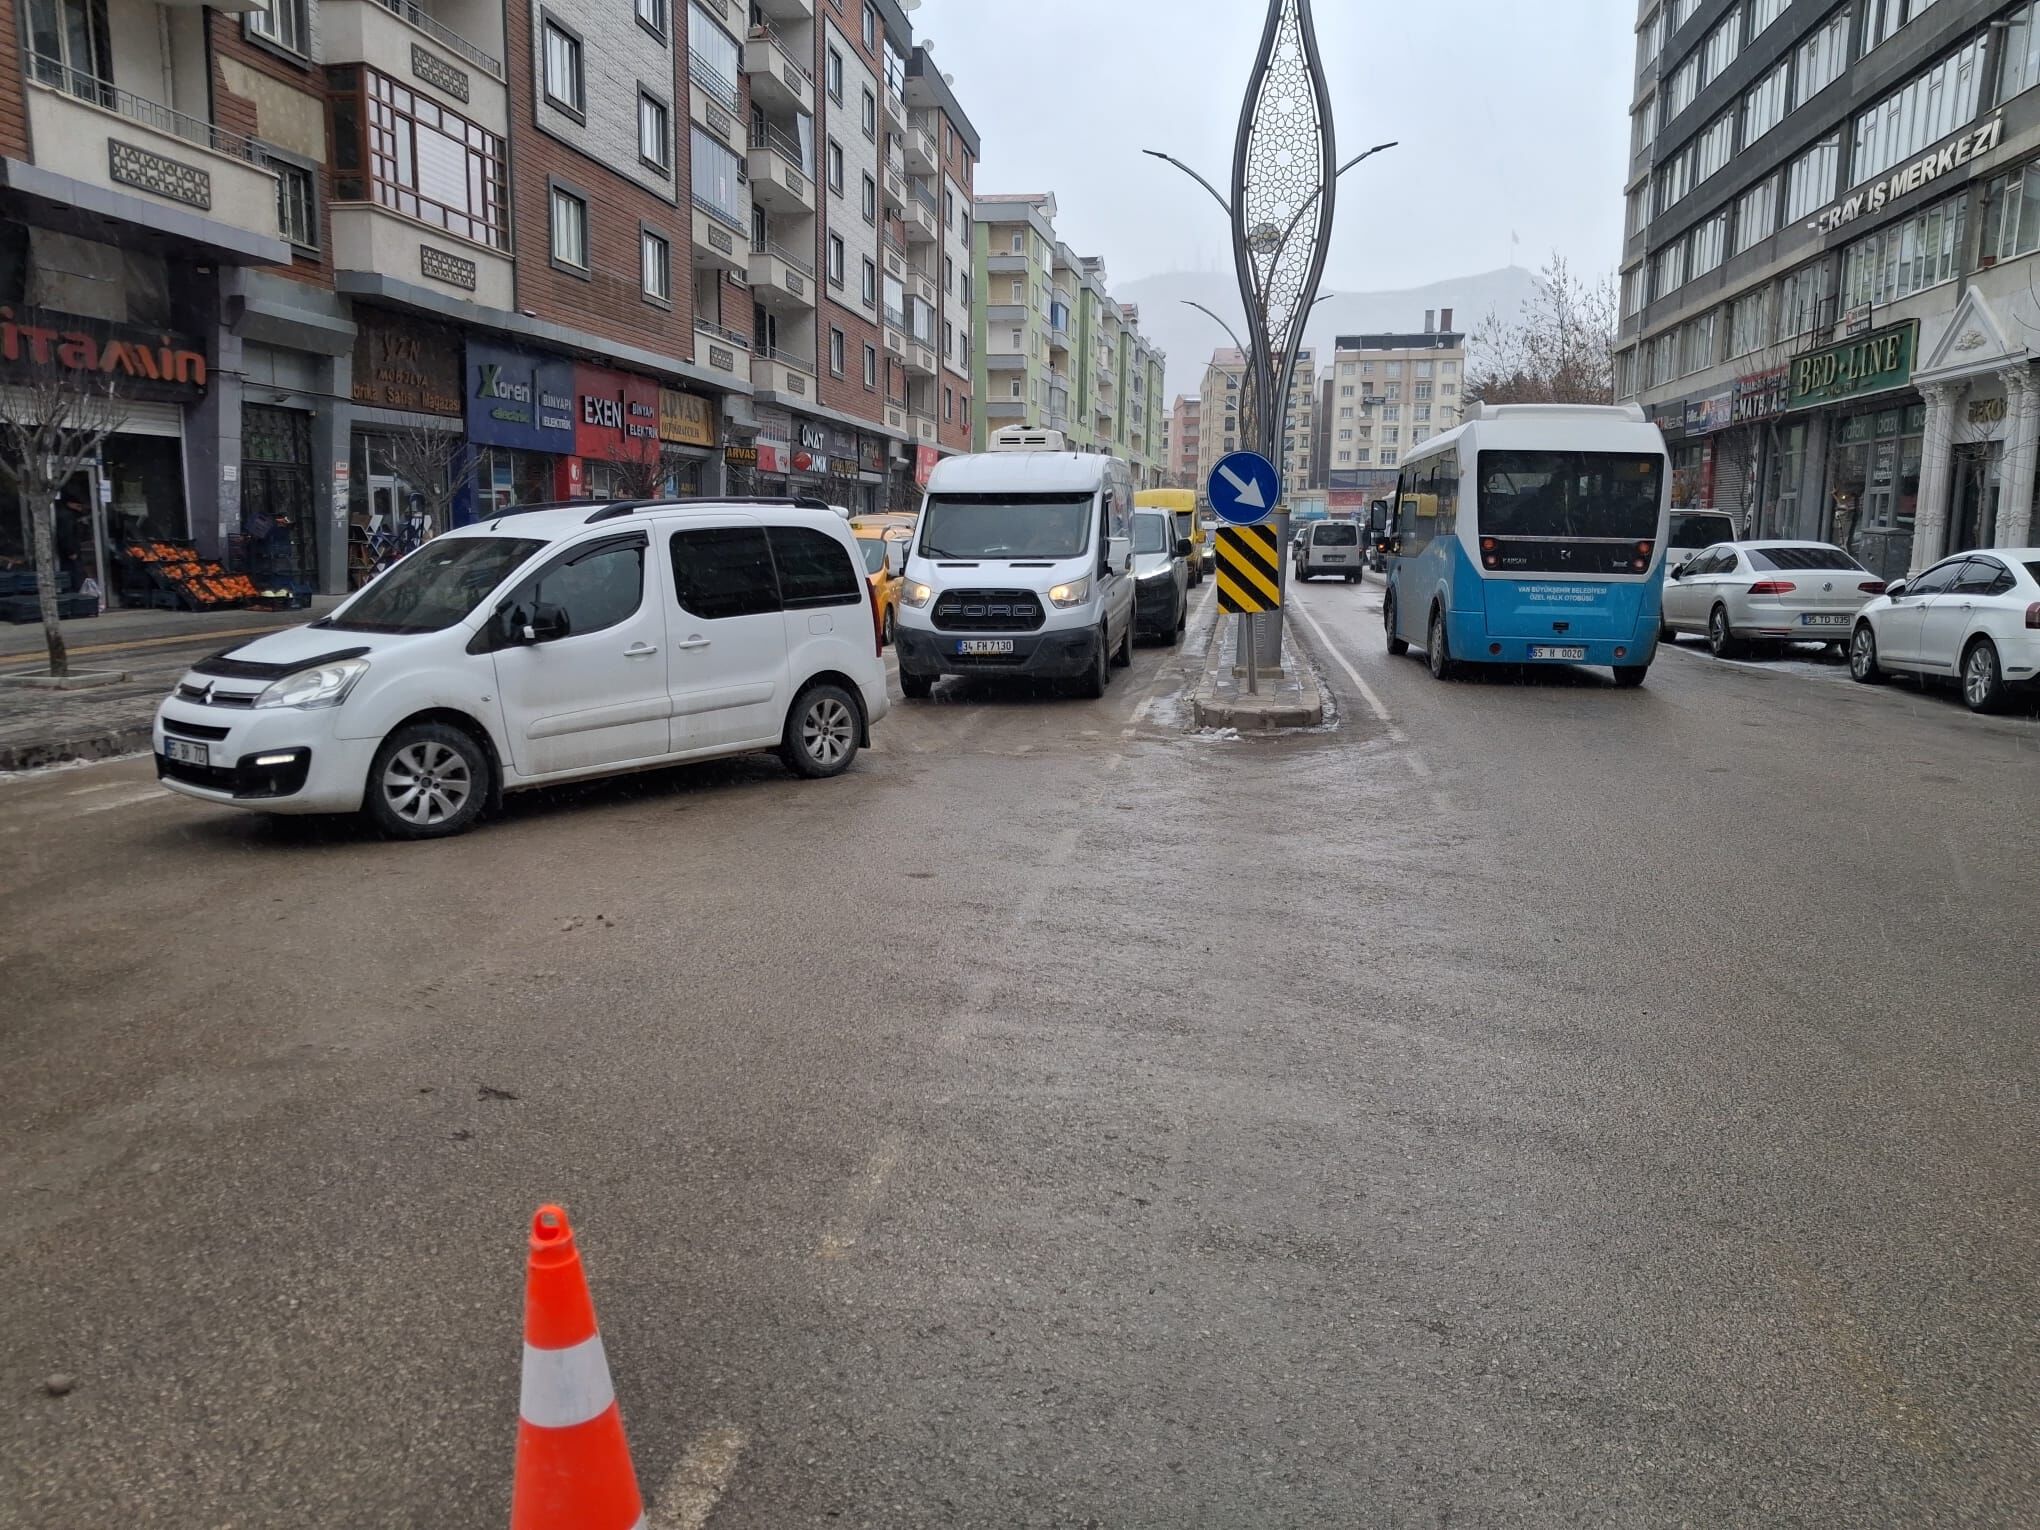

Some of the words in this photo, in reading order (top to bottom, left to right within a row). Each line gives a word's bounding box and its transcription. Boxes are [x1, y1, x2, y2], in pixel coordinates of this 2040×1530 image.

[1818, 192, 1864, 236] ERAY
[1890, 108, 2003, 201] MERKEZİ
[352, 383, 377, 400] brika
[584, 395, 622, 429] EXEN
[726, 447, 757, 460] ARVAS
[938, 604, 1037, 617] FORD
[962, 640, 974, 651] 34
[976, 641, 988, 651] FH
[990, 641, 1012, 651] 7130
[1561, 649, 1582, 658] 0020
